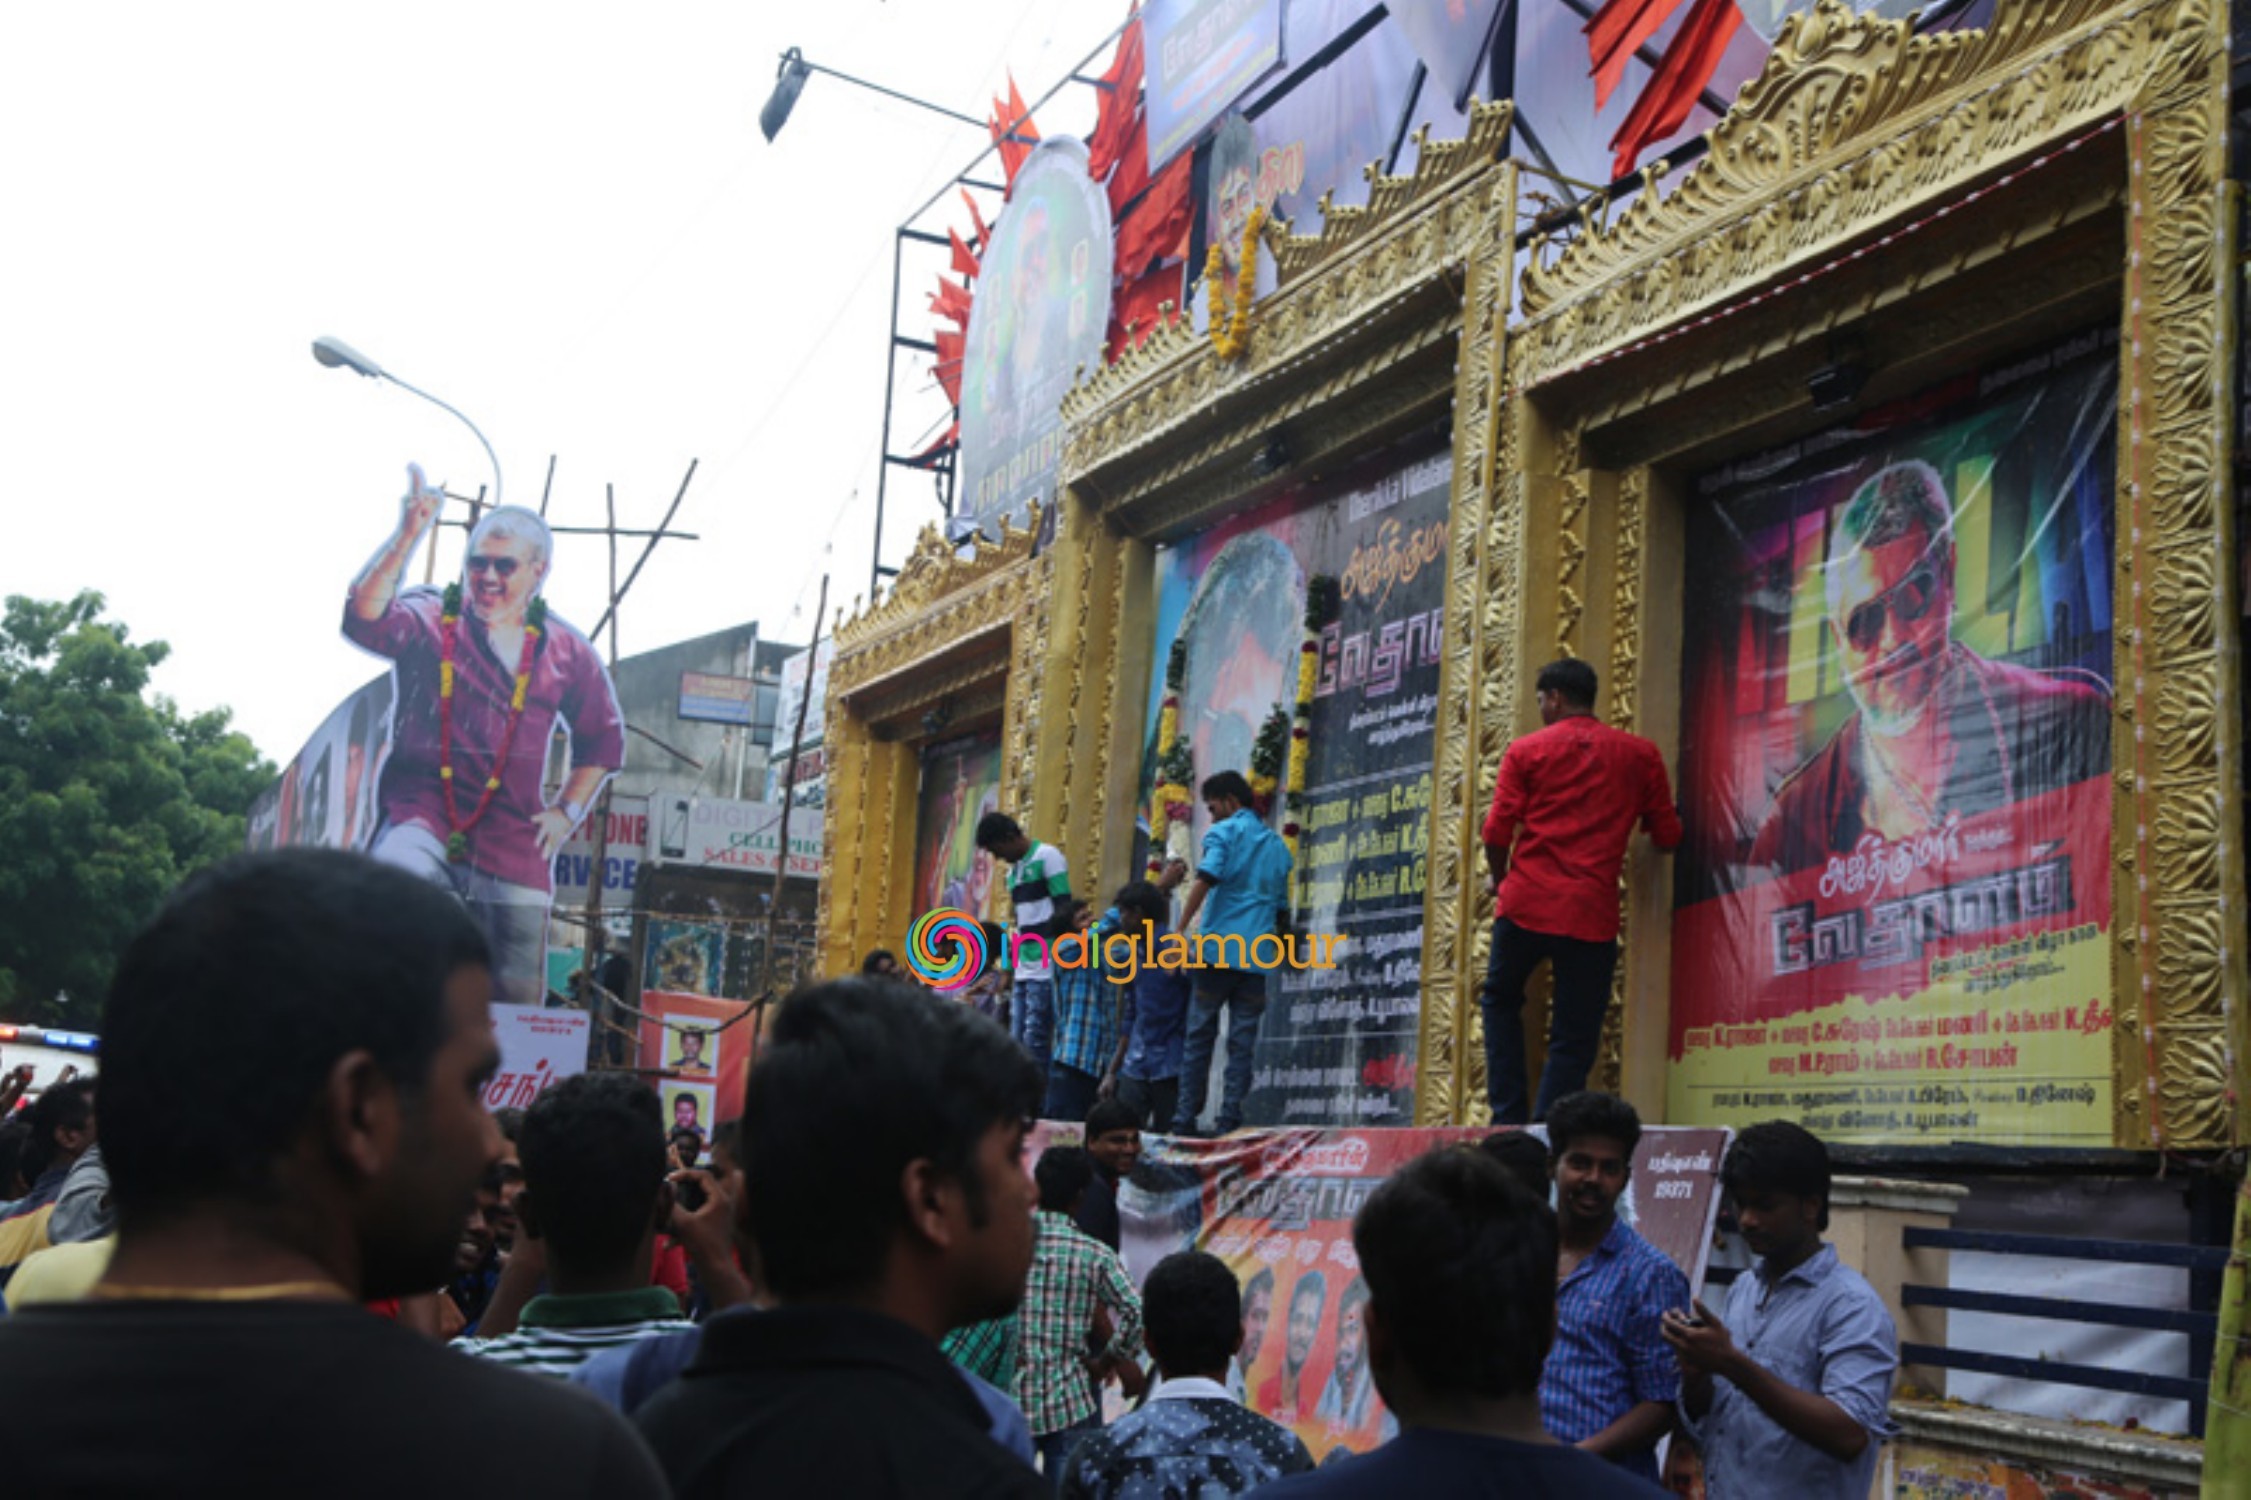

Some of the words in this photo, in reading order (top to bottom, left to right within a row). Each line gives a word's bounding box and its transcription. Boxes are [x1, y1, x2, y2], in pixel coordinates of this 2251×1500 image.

[1314, 606, 1443, 698] வேதா
[570, 811, 647, 846] HONE
[556, 854, 636, 890] RVCE
